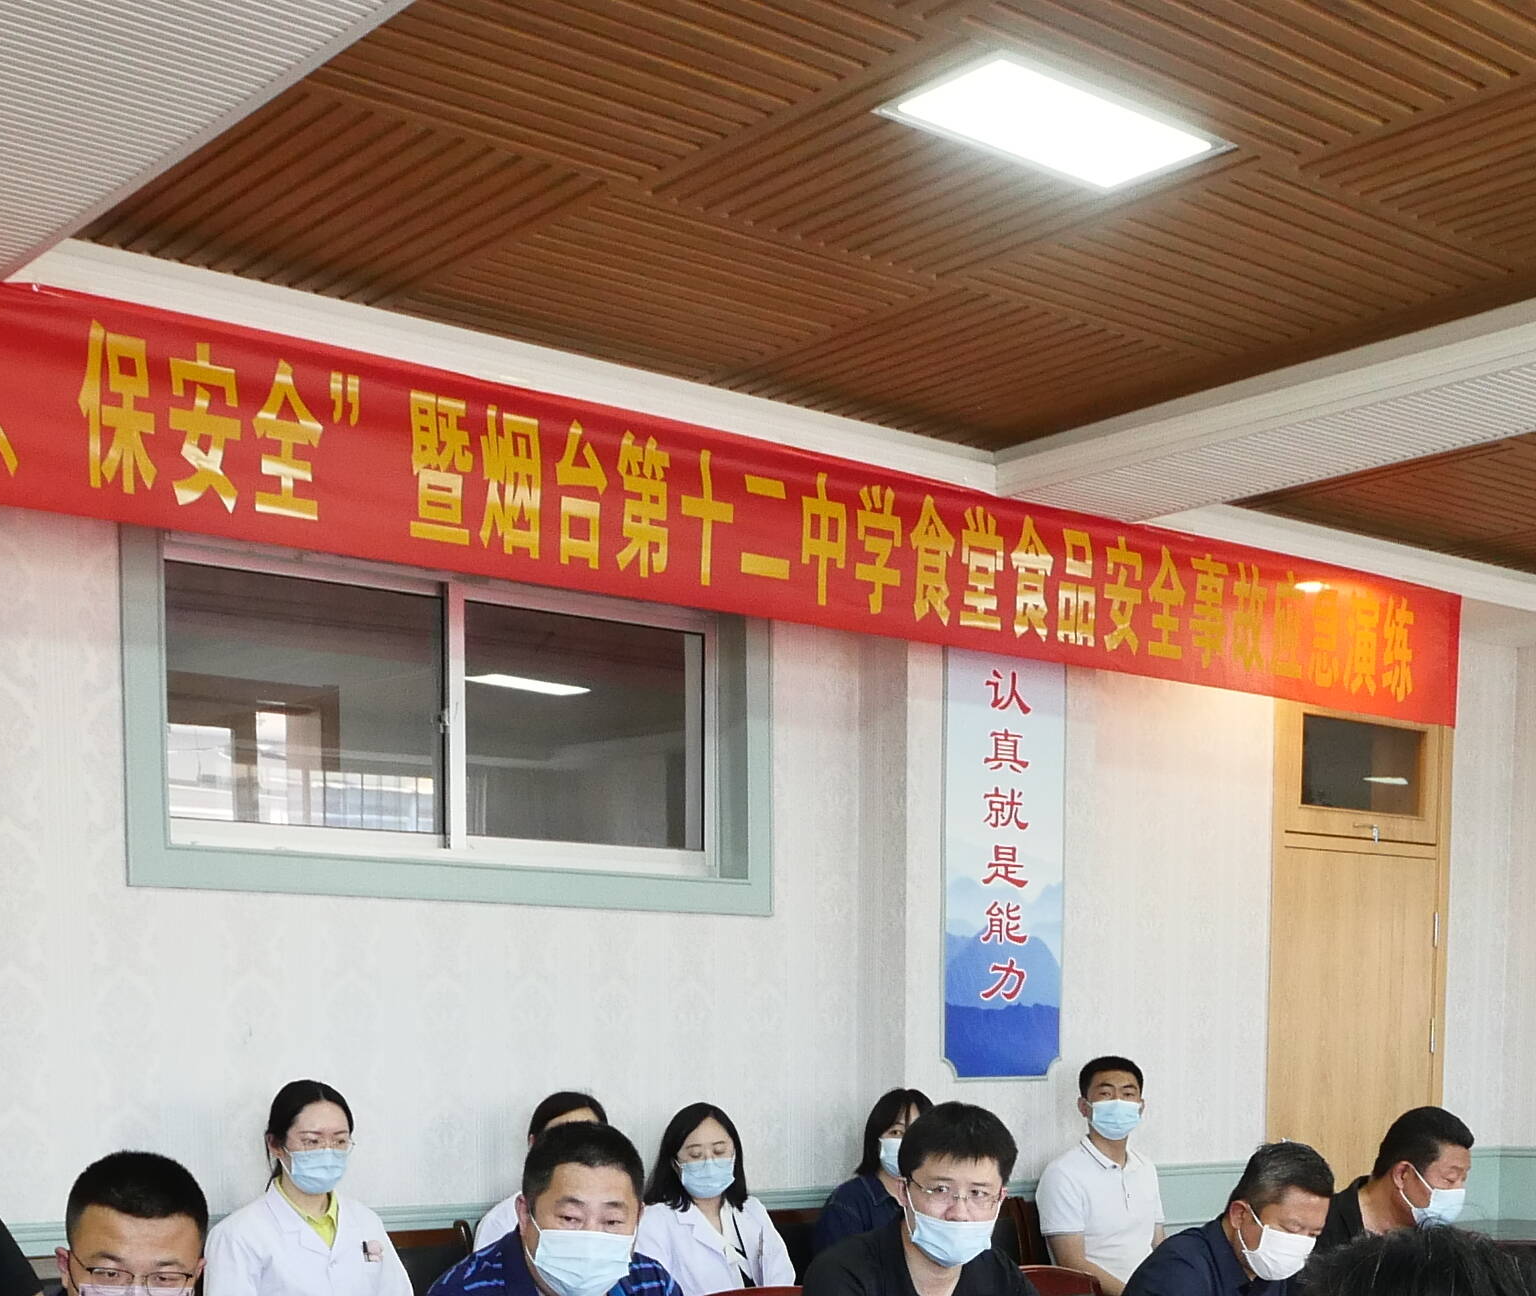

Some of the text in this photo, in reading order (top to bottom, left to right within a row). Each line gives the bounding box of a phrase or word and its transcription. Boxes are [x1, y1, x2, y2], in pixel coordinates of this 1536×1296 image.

[980, 668, 1032, 1001] 认真就是能力
